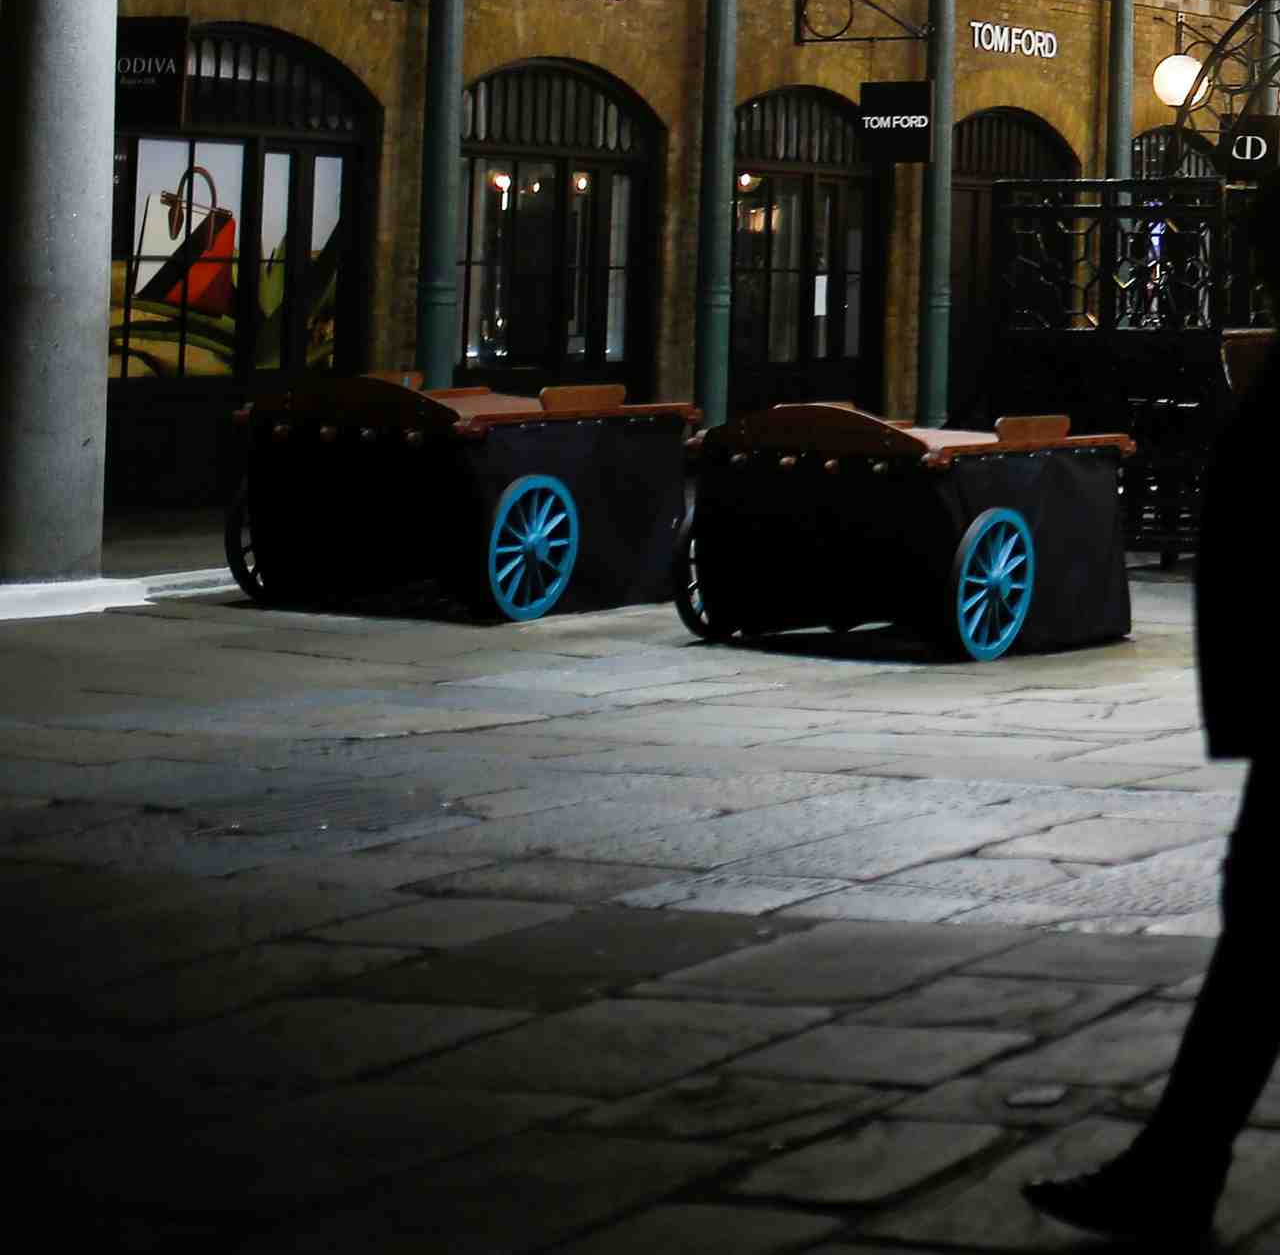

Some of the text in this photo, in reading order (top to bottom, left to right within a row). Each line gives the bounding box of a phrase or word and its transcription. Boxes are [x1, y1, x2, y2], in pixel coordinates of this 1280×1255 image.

[970, 21, 1057, 58] TOM FORD
[117, 57, 176, 74] ODIVA
[862, 114, 929, 129] TOM FORD
